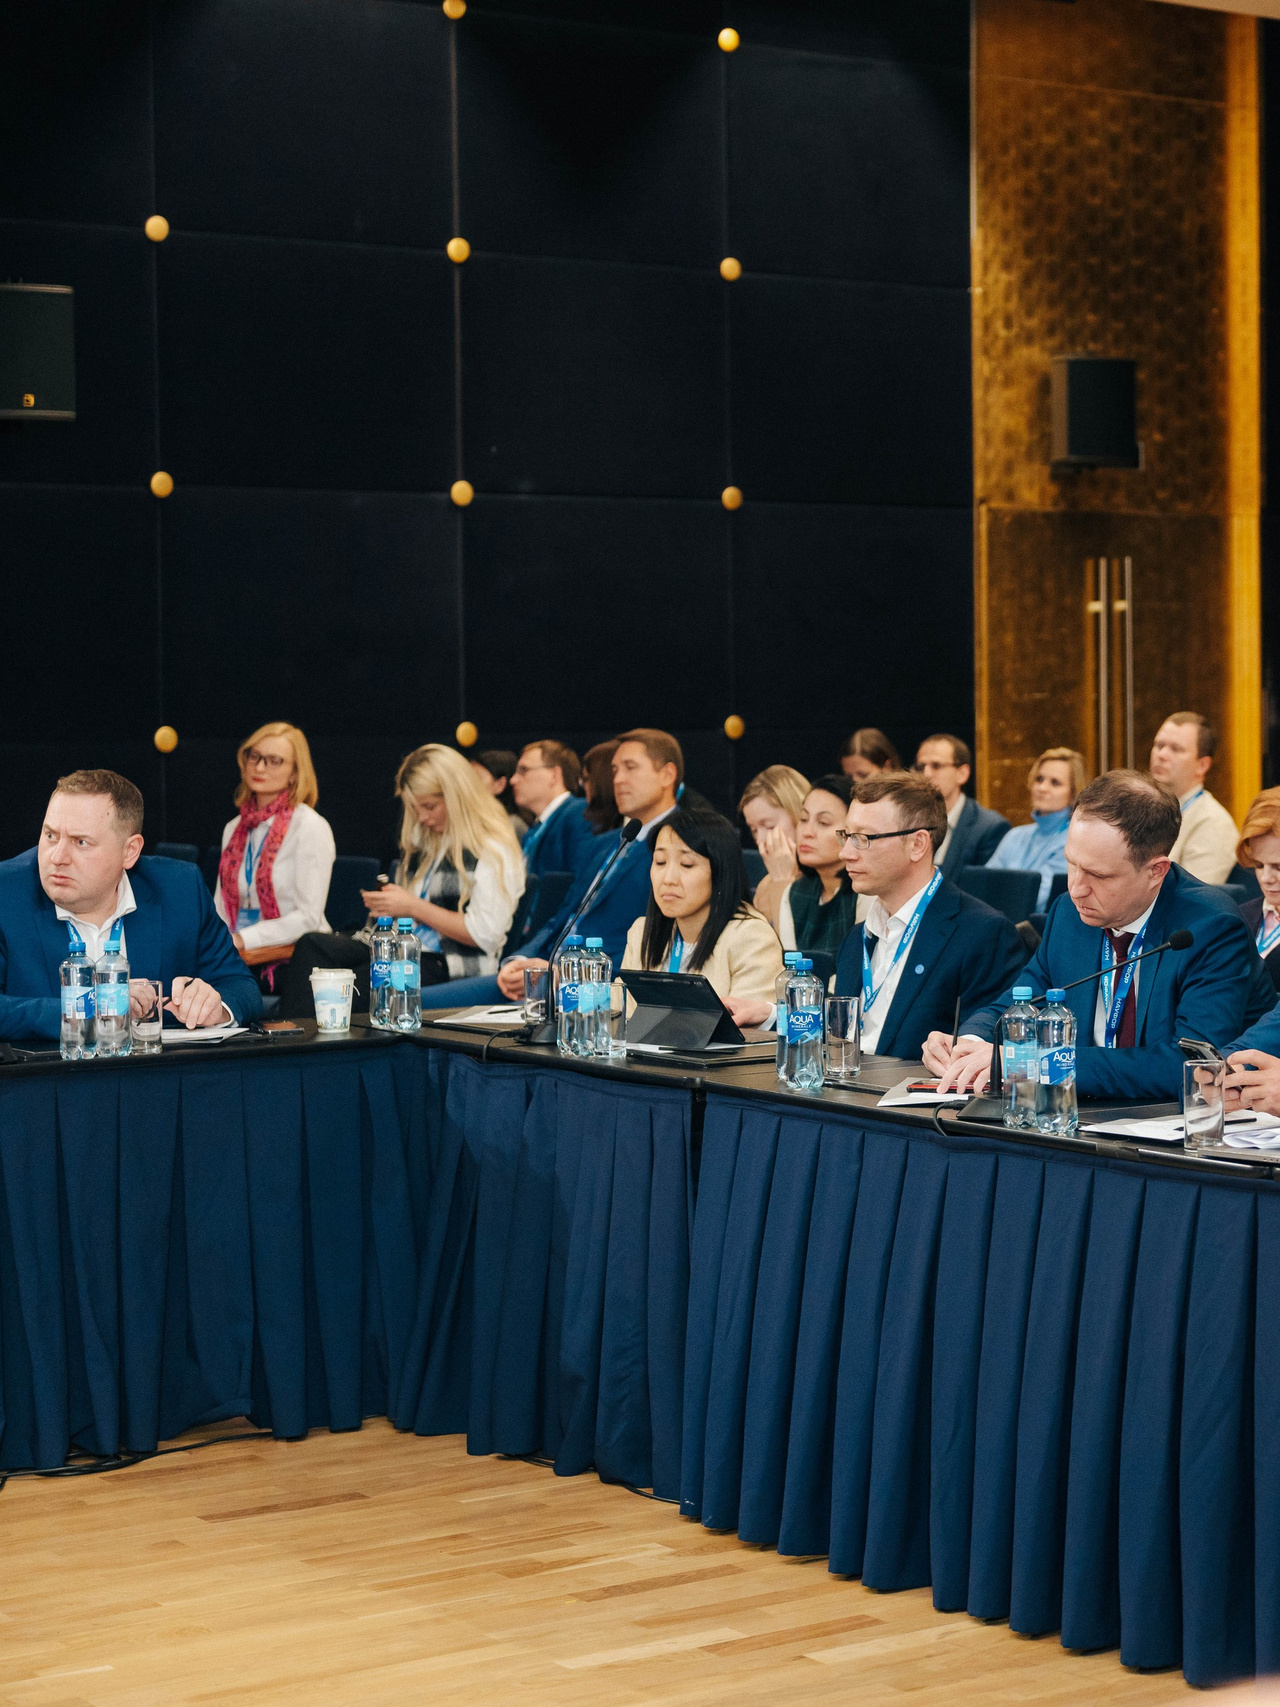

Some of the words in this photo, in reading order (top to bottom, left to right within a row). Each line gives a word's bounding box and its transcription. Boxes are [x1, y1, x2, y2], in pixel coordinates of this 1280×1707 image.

[903, 913, 920, 944] НАУФОР
[1124, 951, 1136, 984] НУФОР
[790, 1014, 814, 1026] AQUA
[1111, 998, 1122, 1029] НАУФОР
[1053, 1050, 1076, 1063] AQUA
